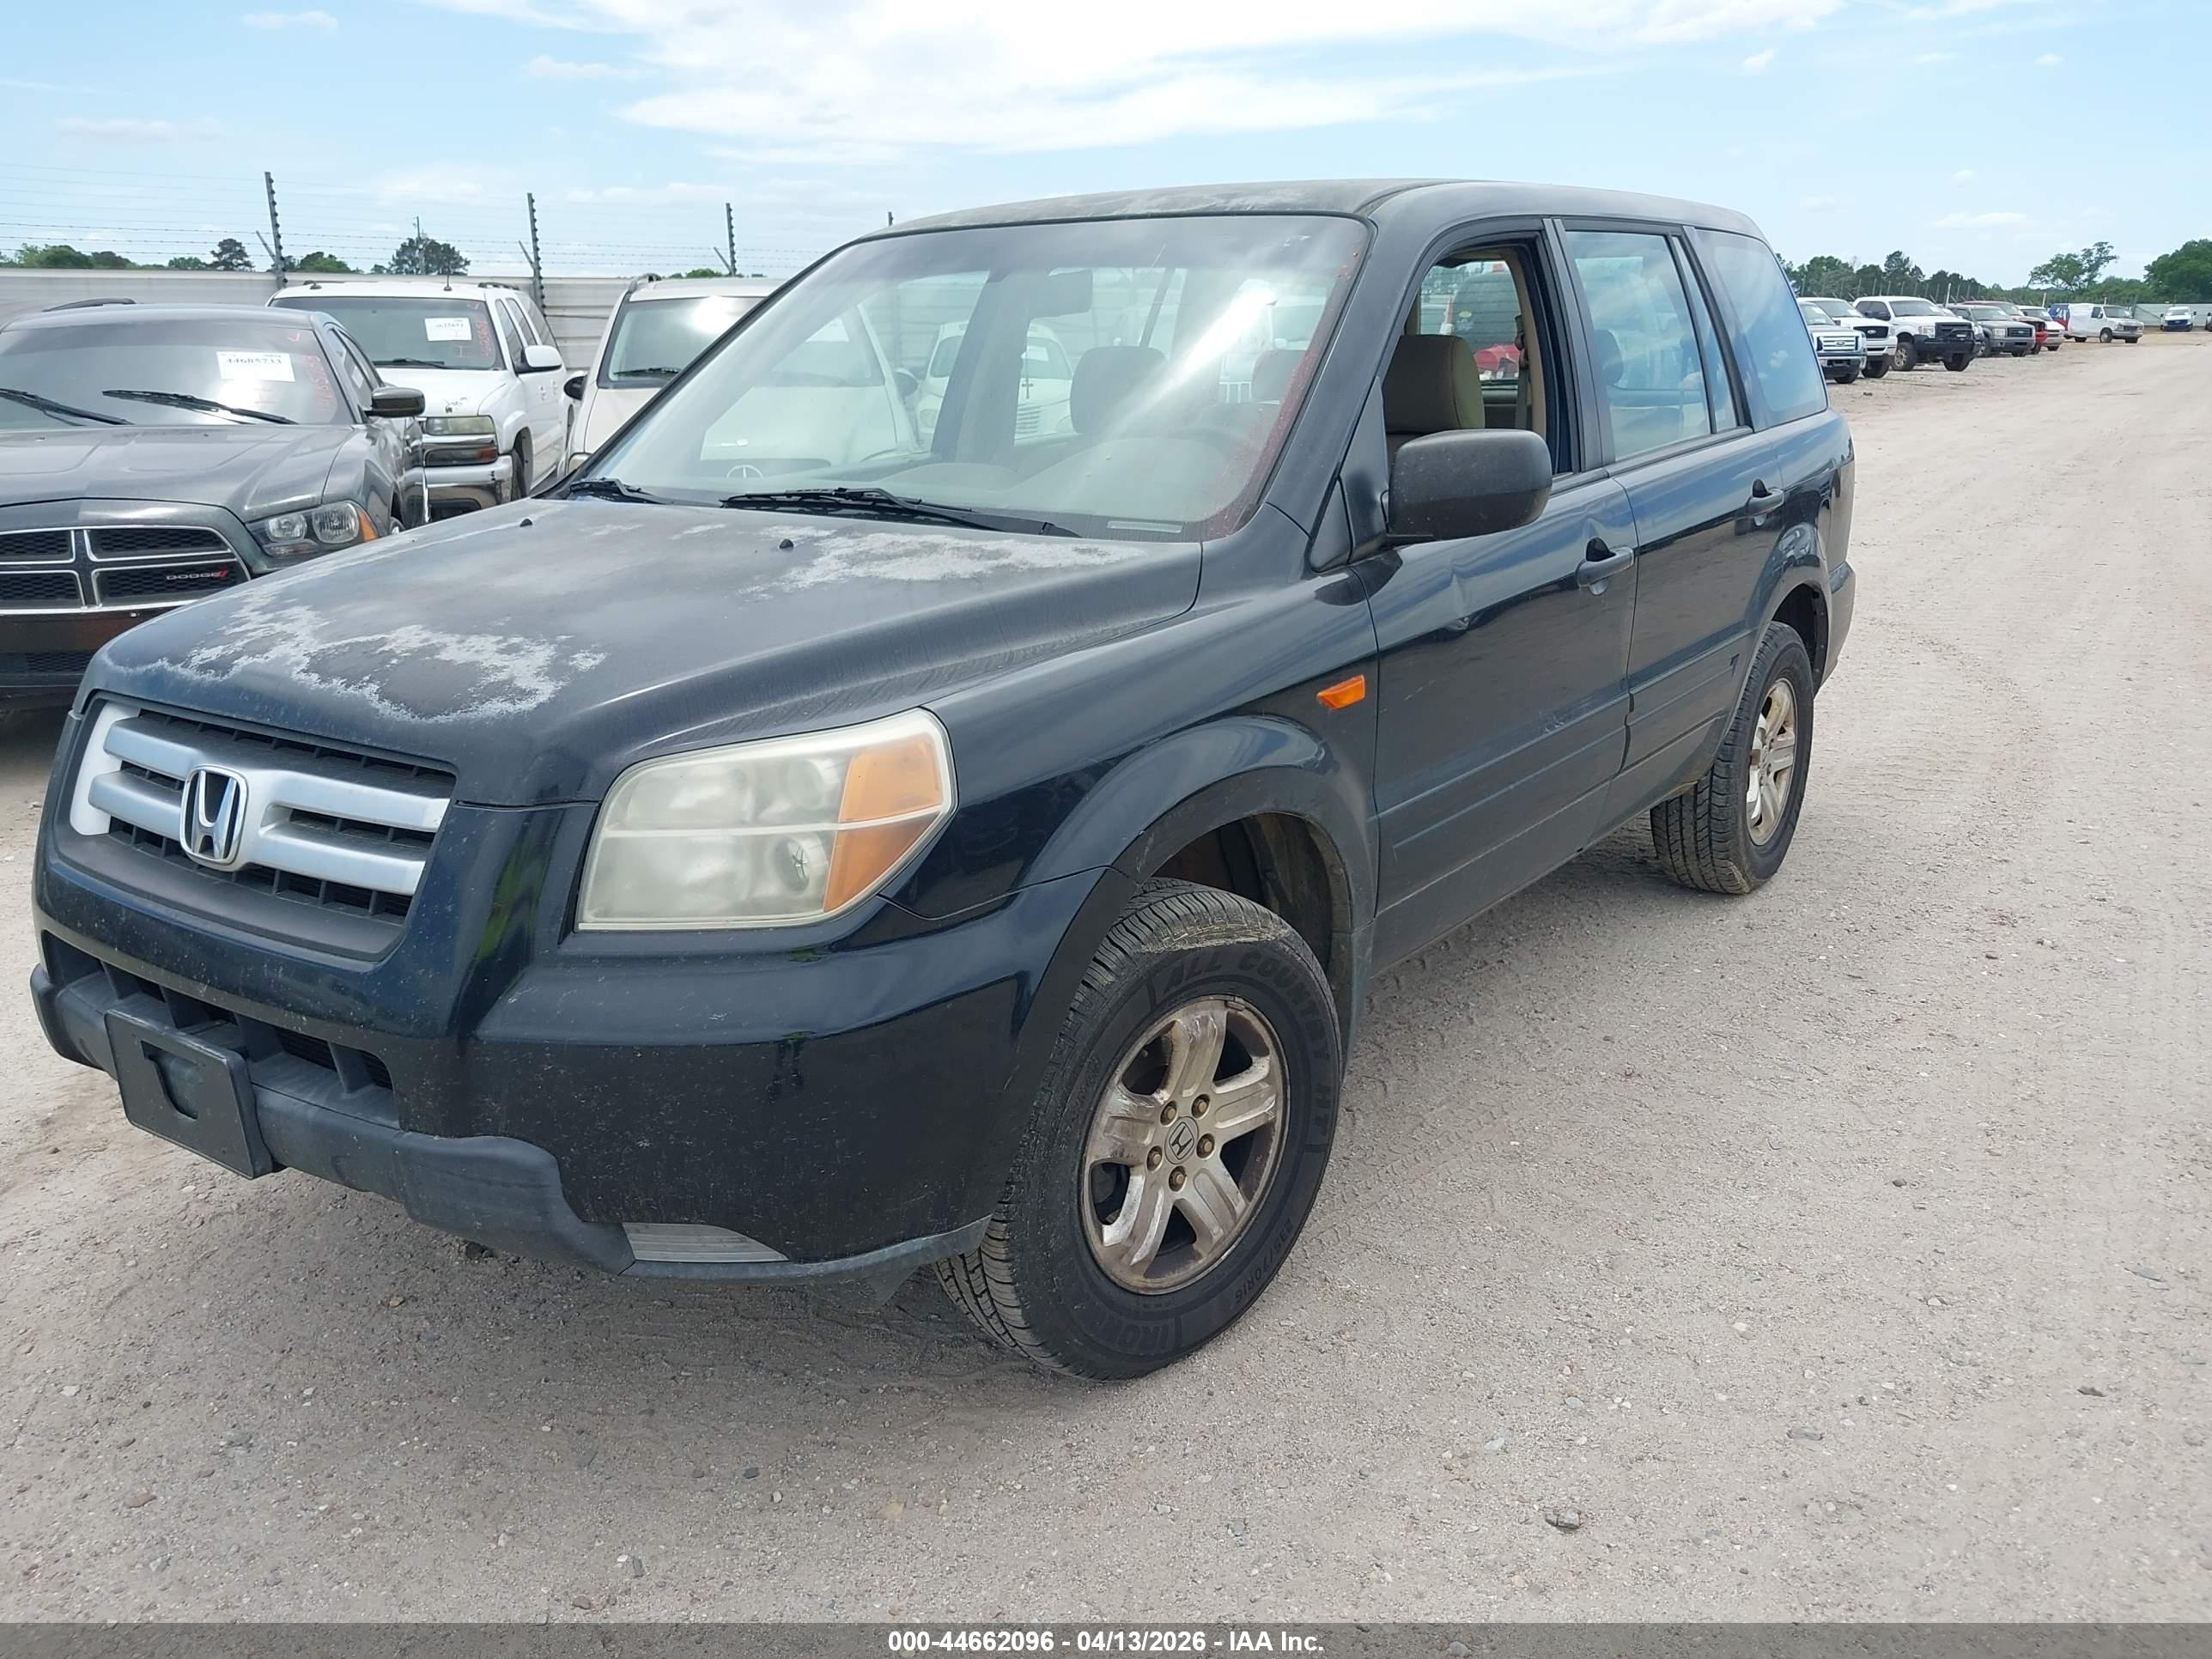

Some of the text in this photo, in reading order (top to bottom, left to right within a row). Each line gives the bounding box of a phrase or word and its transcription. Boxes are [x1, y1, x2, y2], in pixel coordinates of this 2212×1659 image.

[166, 571, 222, 580] DODGE
[1164, 951, 1223, 994] ALL
[1238, 950, 1330, 1061] COUNTRY
[1235, 1217, 1294, 1305] 235/70R16
